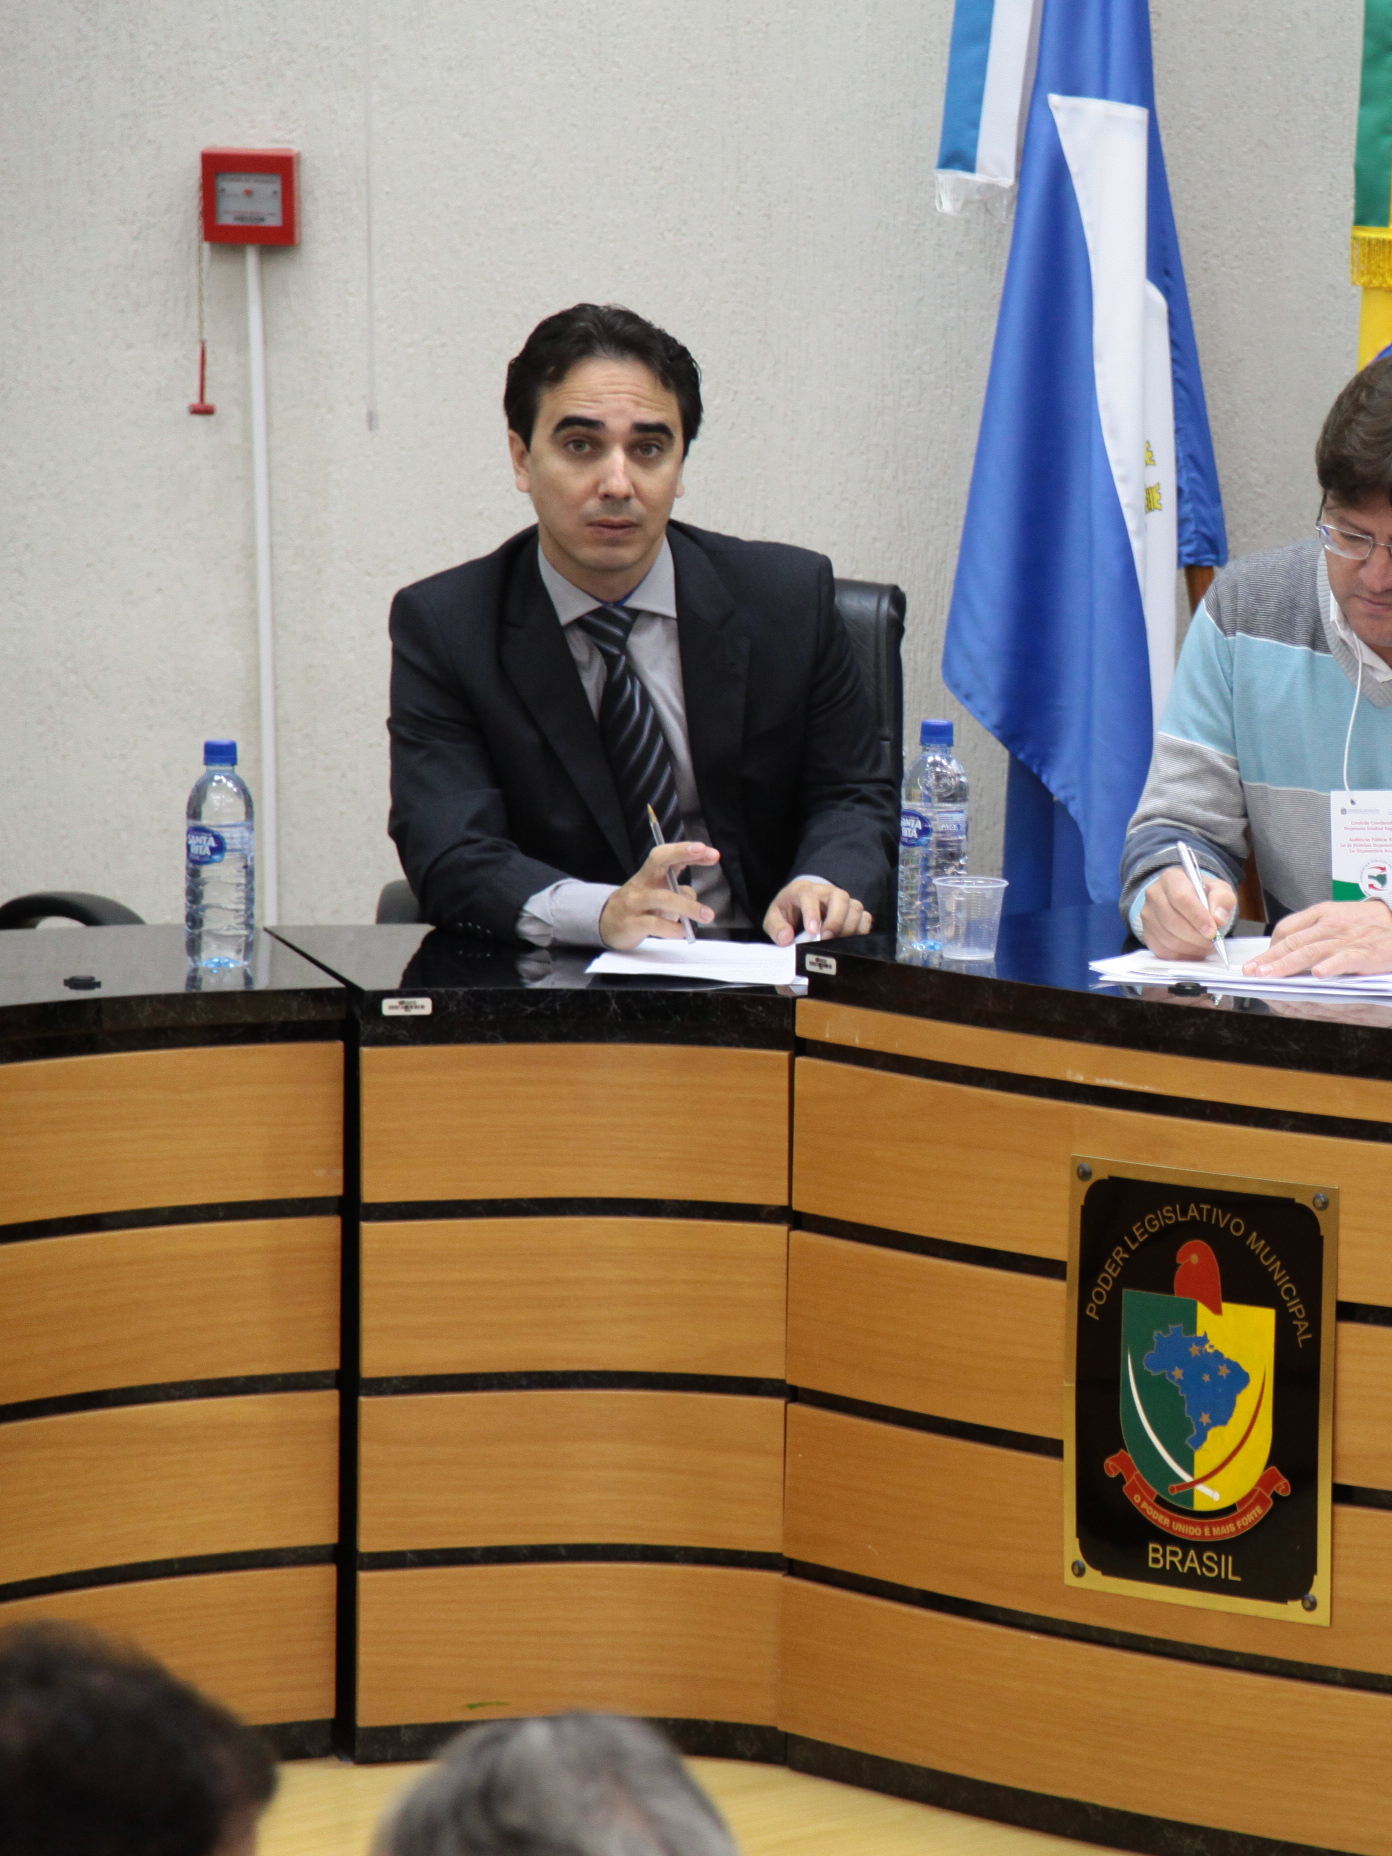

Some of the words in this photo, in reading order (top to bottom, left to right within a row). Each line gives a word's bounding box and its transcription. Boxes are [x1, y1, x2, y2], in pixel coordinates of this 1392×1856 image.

[1085, 1245, 1130, 1321] PODER
[1123, 1202, 1246, 1251] LEGISLATIVO
[1246, 1231, 1313, 1349] MUNICIPAL
[1133, 1494, 1141, 1504] O
[1140, 1501, 1171, 1527] PODER
[1171, 1520, 1202, 1537] UNIDO
[1212, 1523, 1236, 1536] MAIS
[1237, 1505, 1264, 1530] FORTE
[1147, 1541, 1242, 1582] BRASIL
